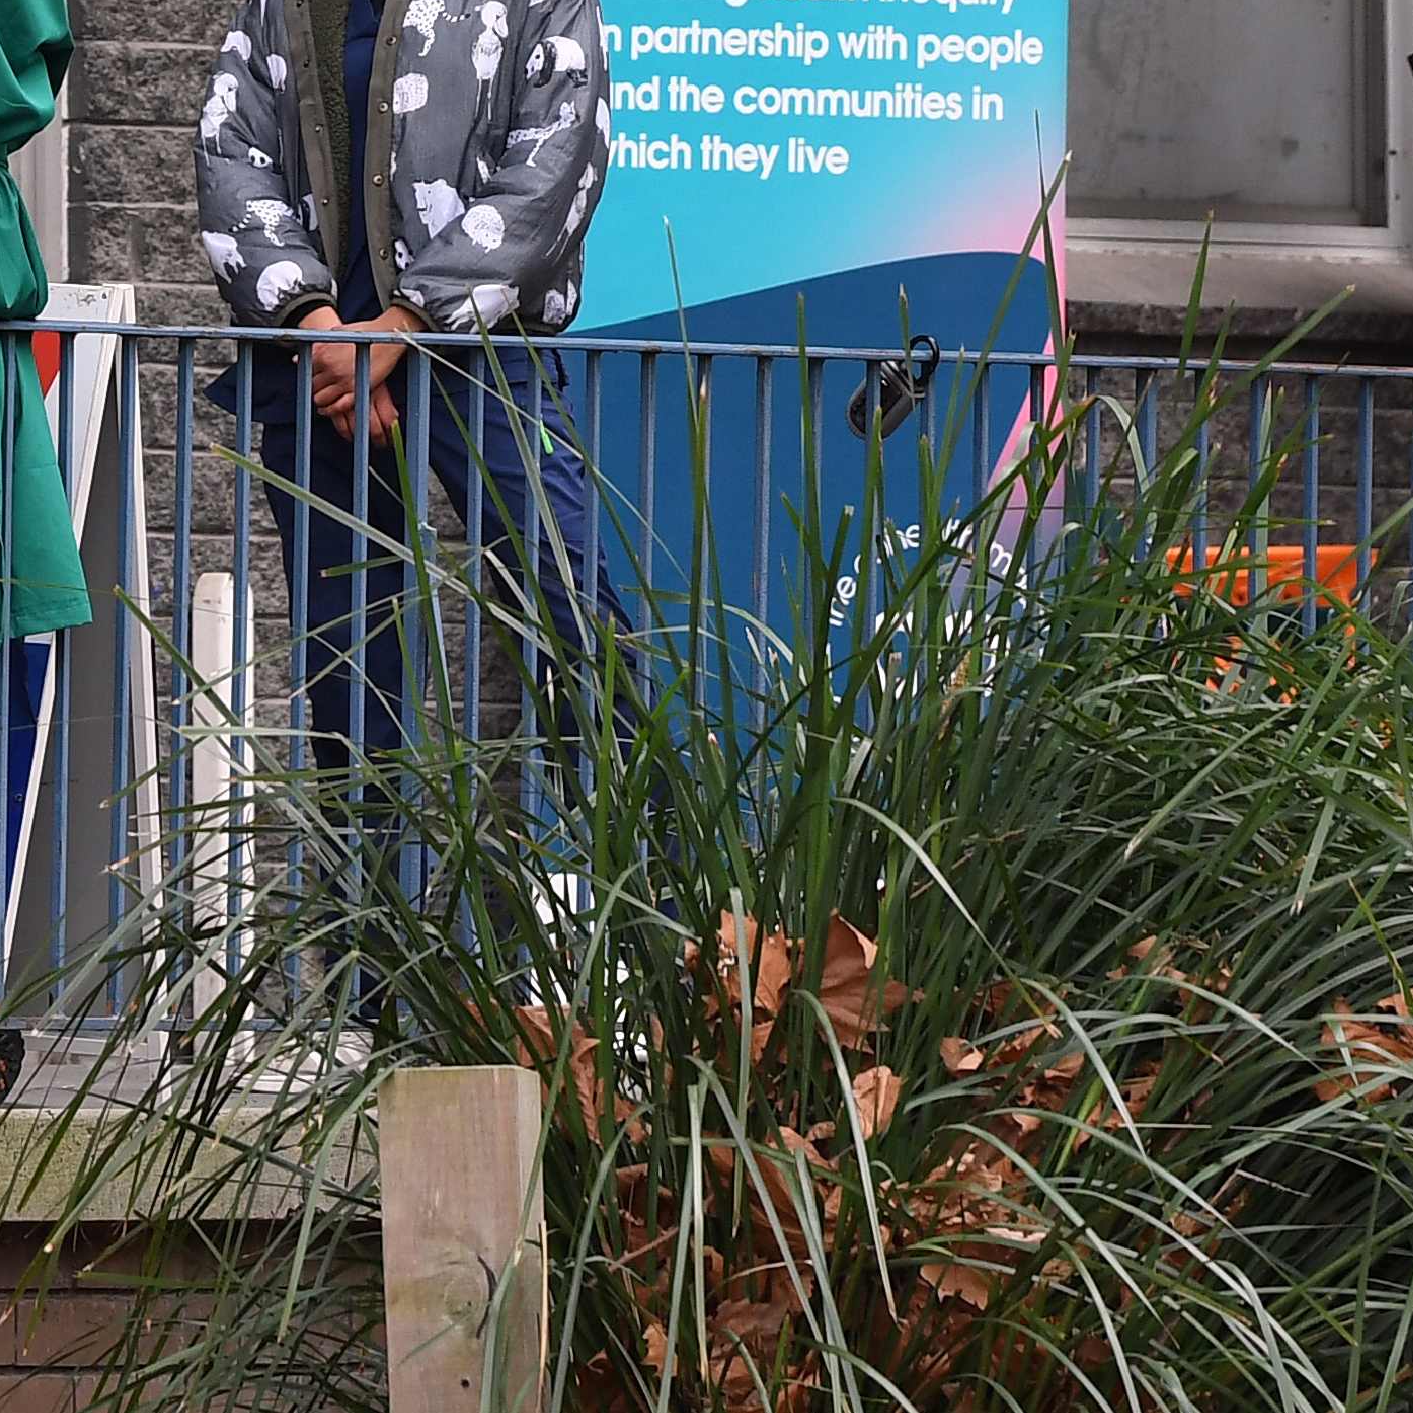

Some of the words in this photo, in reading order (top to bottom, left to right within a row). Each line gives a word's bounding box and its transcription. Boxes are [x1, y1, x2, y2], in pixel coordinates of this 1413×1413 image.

[631, 20, 829, 65] partnership
[838, 25, 907, 60] with
[918, 30, 1043, 71] people
[610, 76, 660, 110] nd
[668, 76, 724, 113] the
[734, 83, 963, 120] communities
[972, 86, 1004, 121] in
[701, 135, 779, 179] they
[789, 138, 849, 174] live
